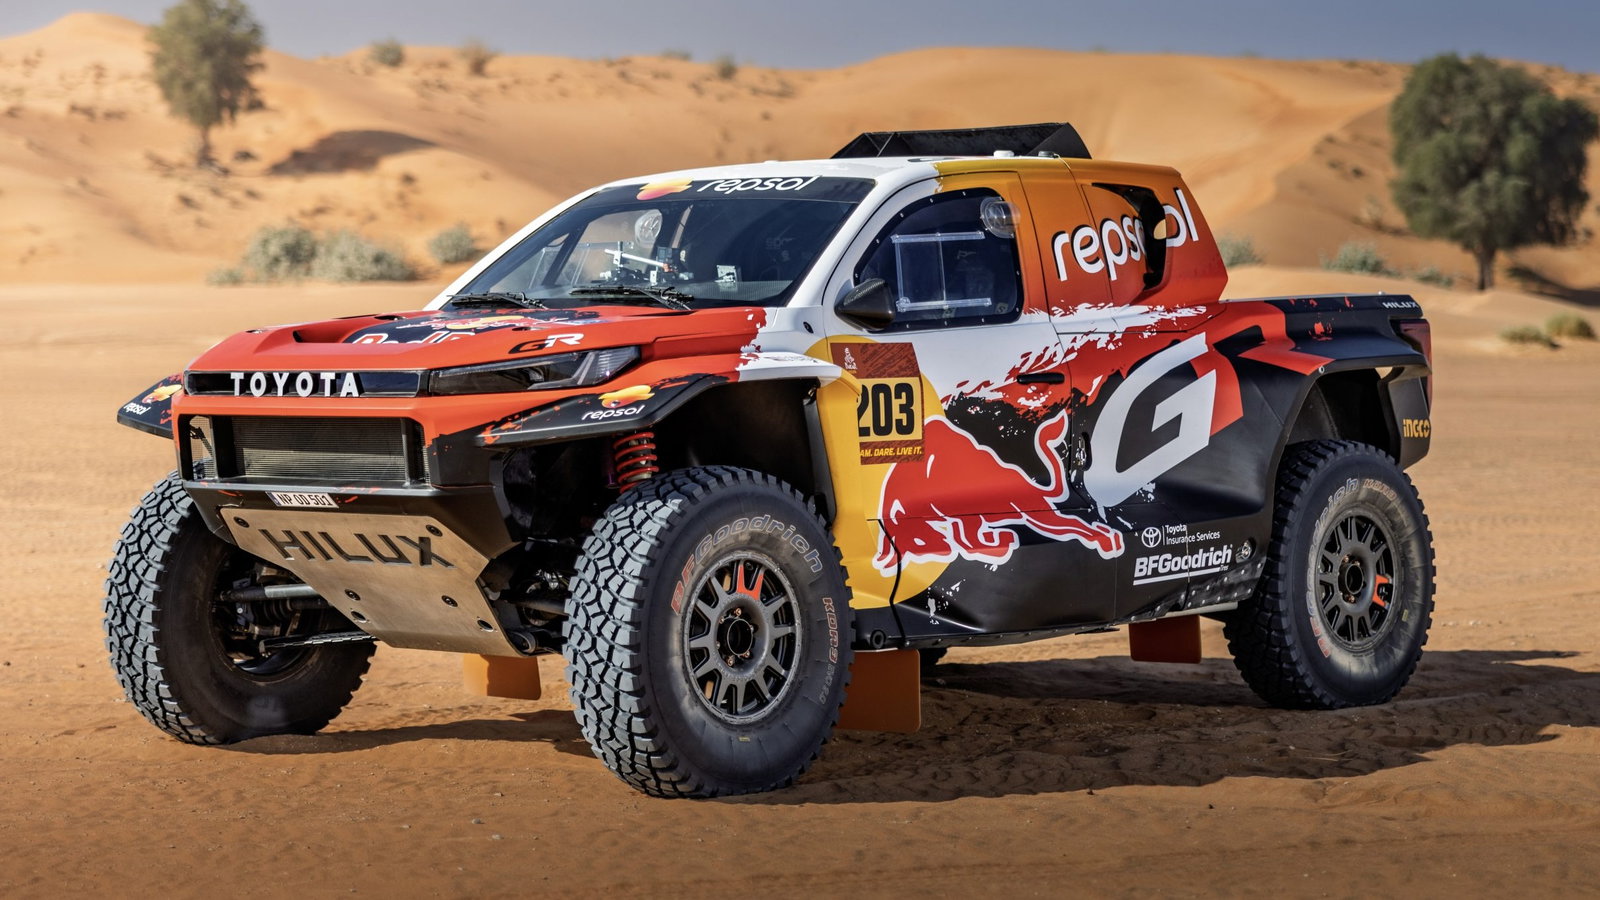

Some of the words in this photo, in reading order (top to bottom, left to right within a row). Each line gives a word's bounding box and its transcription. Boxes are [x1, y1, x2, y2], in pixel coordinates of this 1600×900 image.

[697, 175, 821, 195] repsol
[1052, 187, 1199, 282] repsol
[508, 332, 585, 355] GR
[230, 371, 360, 398] TOYOTA
[123, 402, 152, 415] repsol
[581, 404, 646, 420] repsol
[856, 382, 915, 437] 203
[873, 447, 896, 457] DARE.
[896, 446, 913, 456] LIVE
[276, 493, 293, 505] NP
[1165, 524, 1187, 534] Toyota
[1166, 534, 1195, 546] Insurance
[1196, 530, 1220, 541] Services
[258, 528, 457, 569] HILUX
[671, 514, 823, 616] BFGoodrich
[1134, 544, 1233, 578] BFGoodrich
